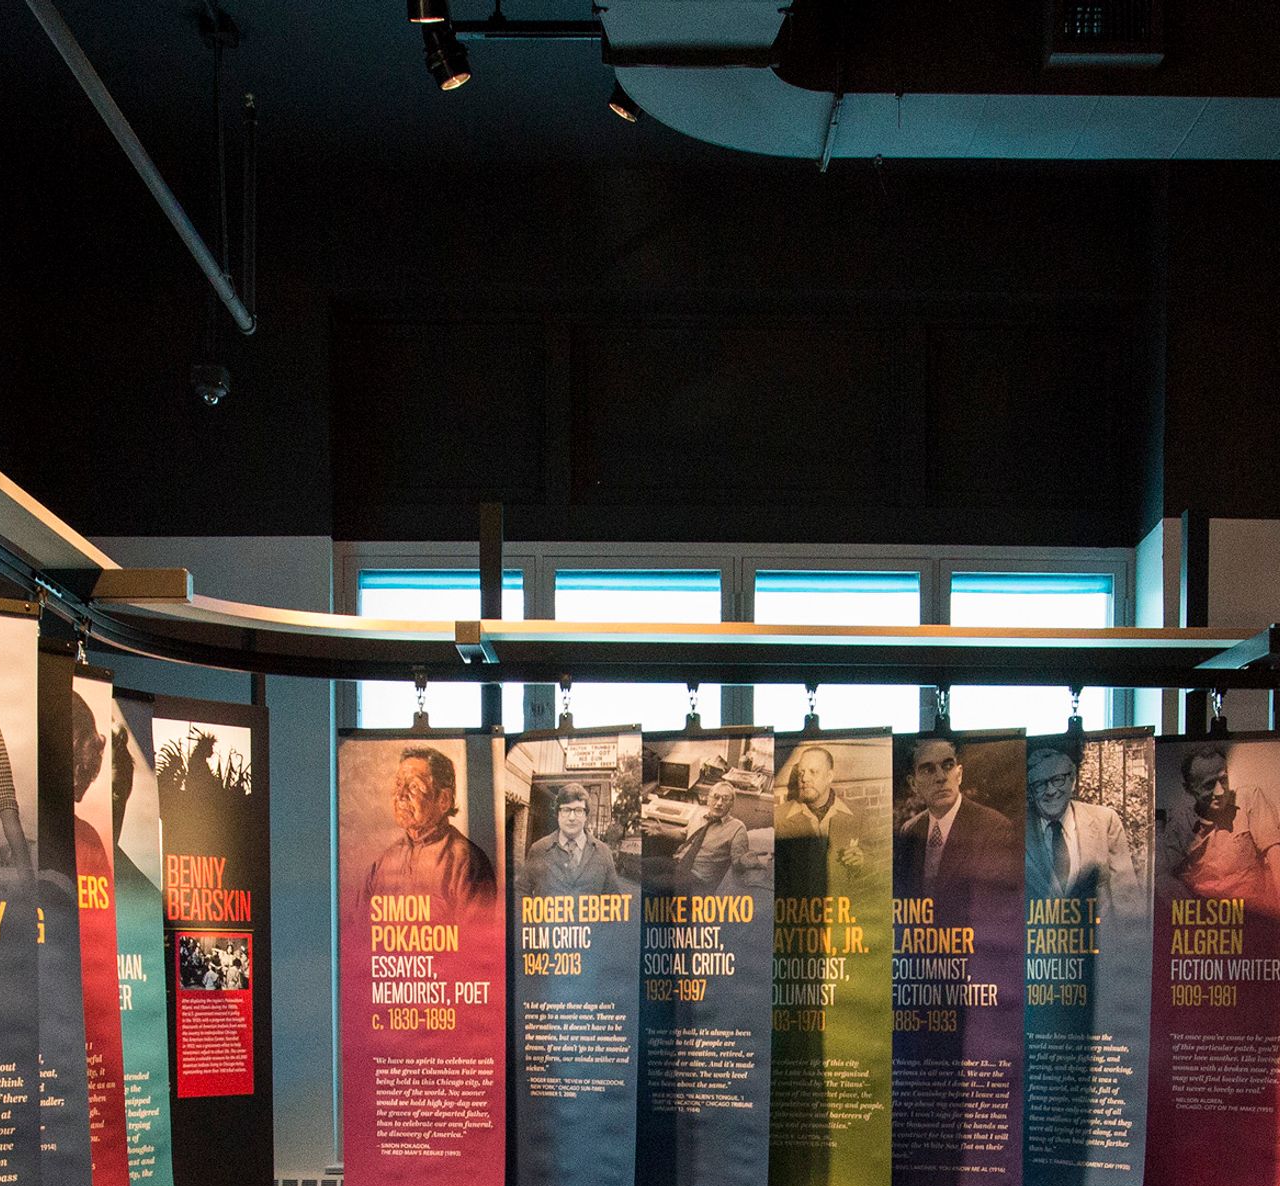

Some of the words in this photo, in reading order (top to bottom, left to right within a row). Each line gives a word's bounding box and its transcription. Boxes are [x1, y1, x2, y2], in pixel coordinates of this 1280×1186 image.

[166, 854, 226, 888] BENNY
[167, 889, 252, 922] BEARSKIN
[370, 895, 430, 922] SIMON
[522, 896, 574, 923] ROGER
[578, 894, 632, 922] EBERT
[644, 896, 688, 923] MIKE
[691, 895, 754, 923] ROYKO
[774, 896, 833, 924] ORACE
[837, 896, 856, 924] R.
[893, 897, 934, 924] RING
[1026, 898, 1081, 925] JAMES
[1087, 897, 1101, 925] T.
[1172, 899, 1245, 926] NELSON
[371, 925, 459, 952] POKAGON
[522, 927, 550, 949] FILM
[552, 925, 591, 949] CRITIC
[644, 926, 724, 951] JOURNALIST,
[774, 926, 837, 956] AYTON,
[842, 926, 870, 953] JR.
[892, 927, 975, 954] LARDNER
[1027, 928, 1100, 954] FARRELL
[1171, 928, 1243, 955] ALGREN
[371, 955, 437, 980] ESSAYIST,
[523, 952, 582, 975] 1942-2013
[644, 953, 689, 975] SOCIAL
[692, 952, 735, 976] CRITIC
[771, 957, 850, 981] OCIOLOGIST,
[892, 958, 972, 982] COLUMNIST,
[1027, 958, 1085, 980] NOVELIST
[1171, 959, 1223, 980] FICTION
[1227, 959, 1280, 981] WRITER
[372, 981, 451, 1006] MEMOIRIST,
[455, 981, 490, 1004] POET
[645, 979, 708, 1001] 1932-1997
[770, 983, 836, 1006] OLUMNIST
[945, 983, 999, 1006] WRITER
[1027, 983, 1087, 1006] 1904-1979
[1171, 984, 1237, 1007] 1909-1981
[372, 1014, 384, 1030] c.
[388, 1007, 456, 1030] 1830-1899
